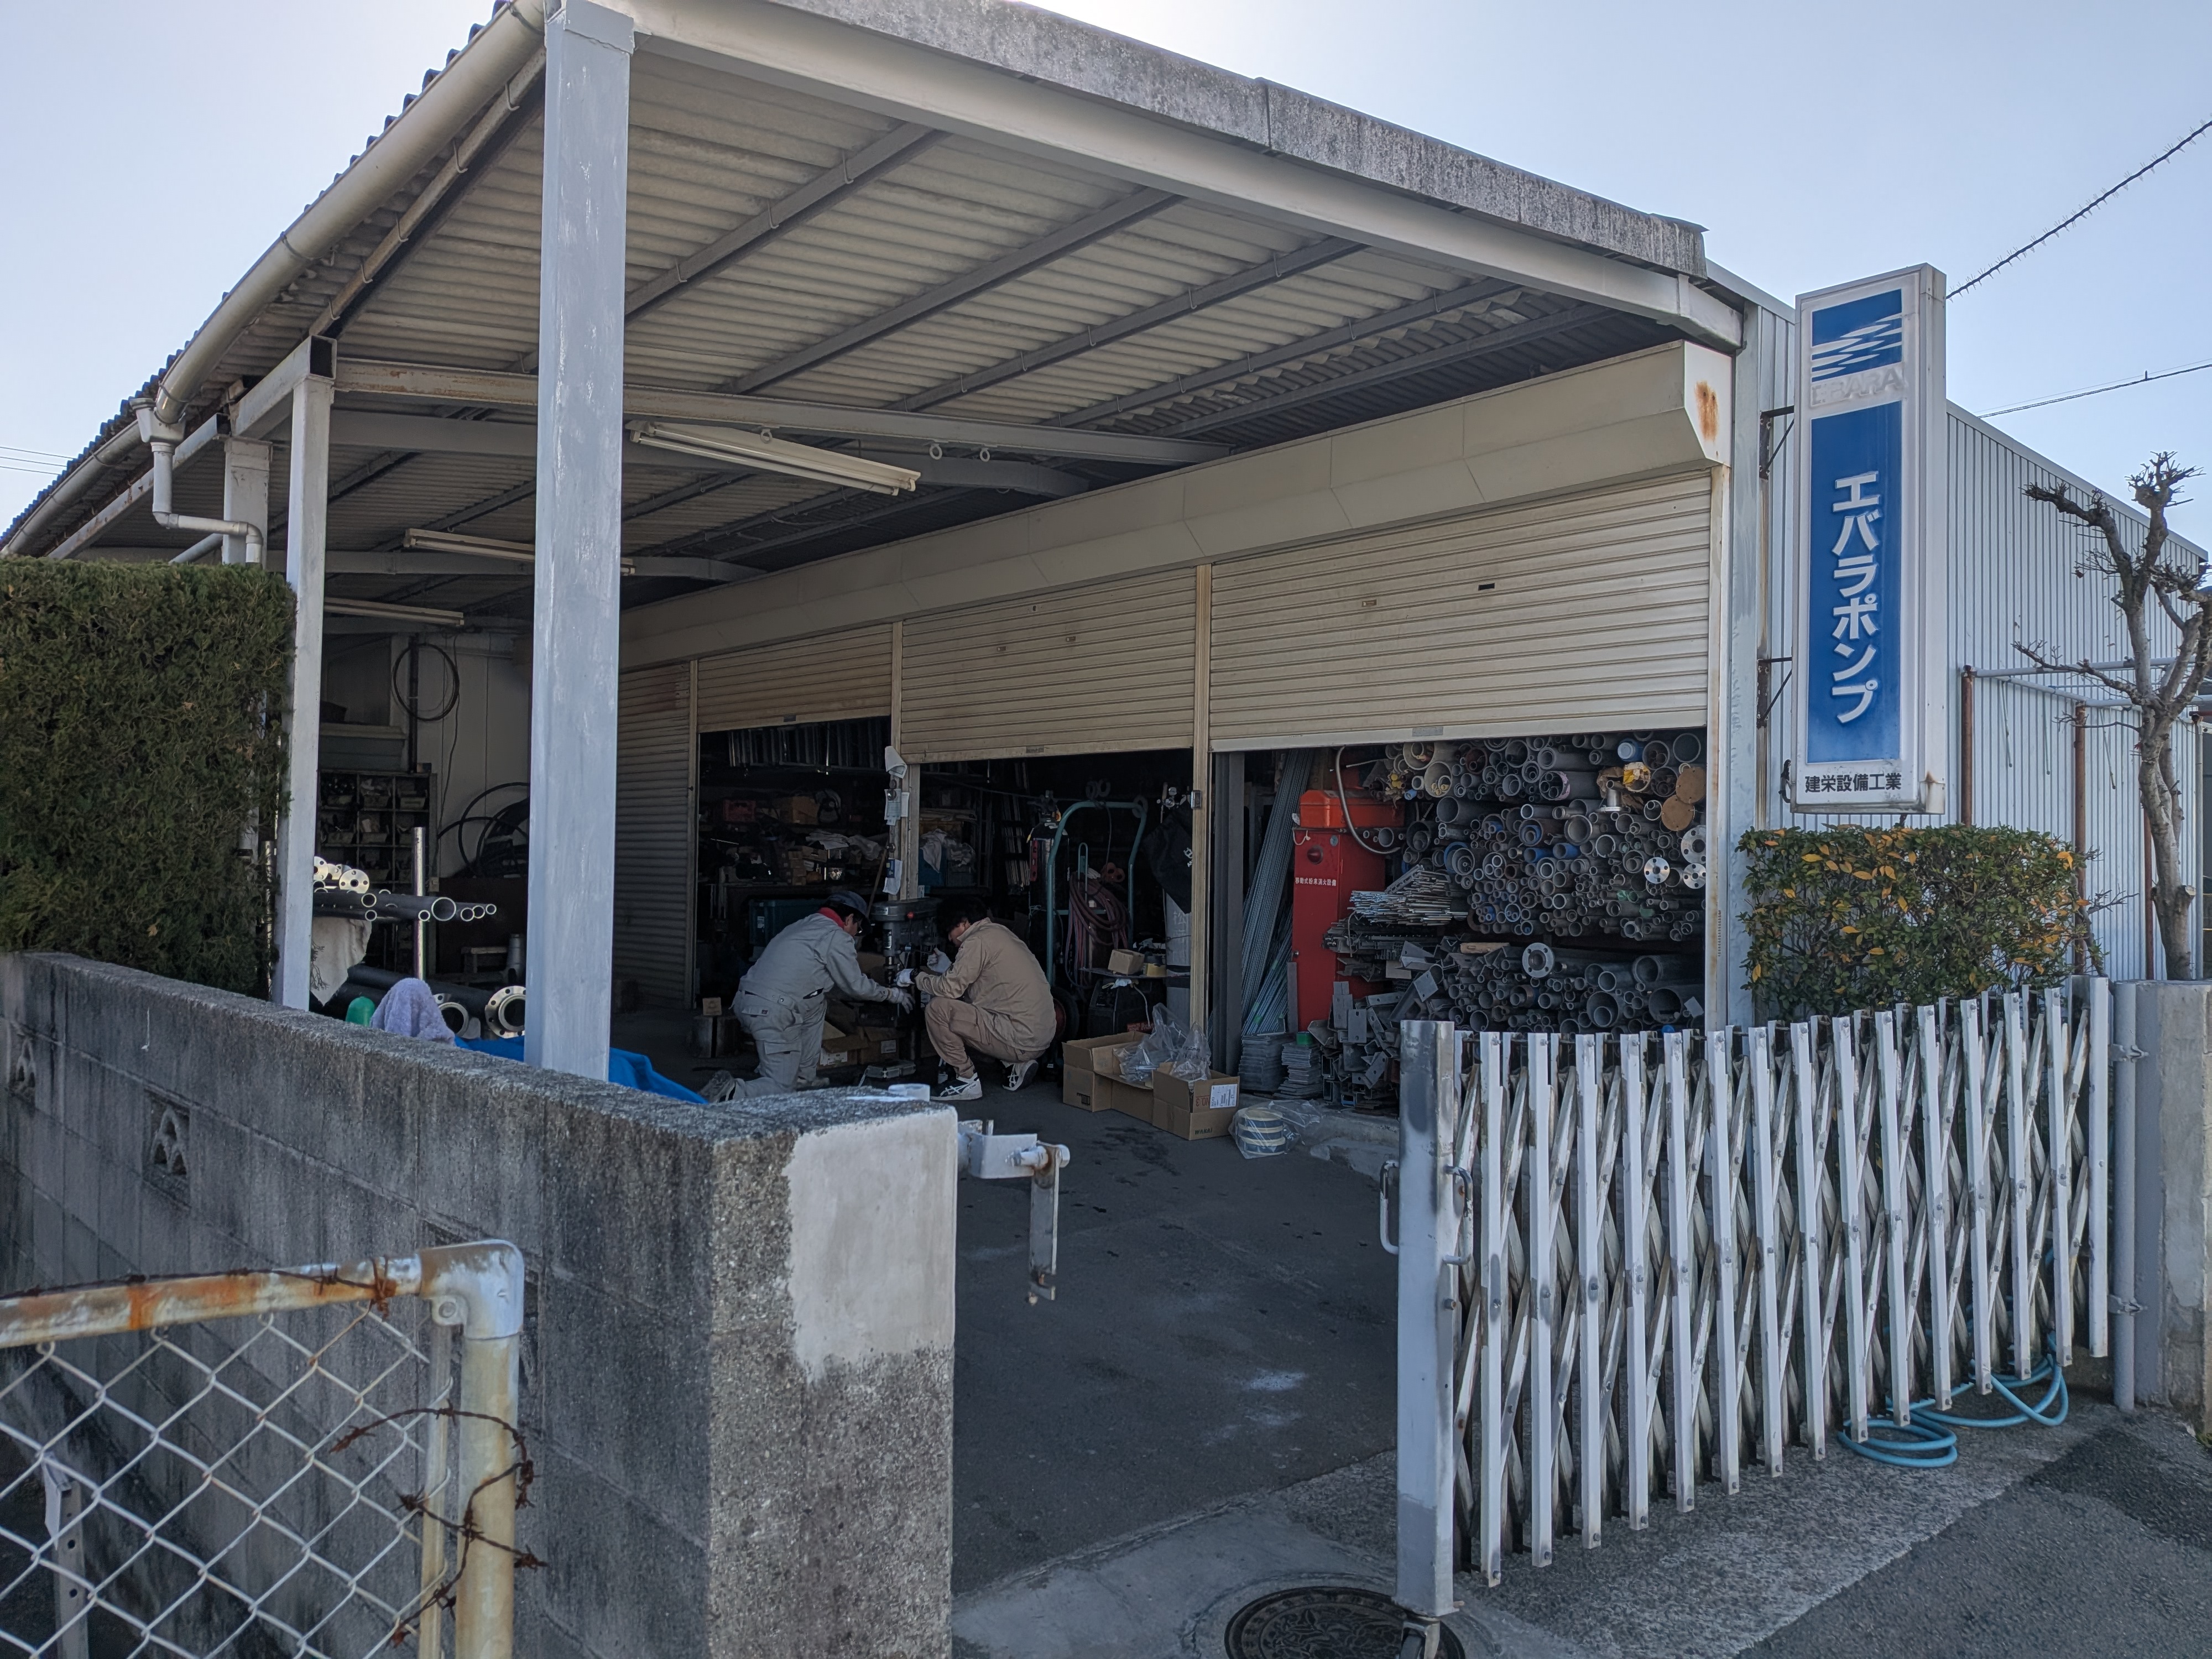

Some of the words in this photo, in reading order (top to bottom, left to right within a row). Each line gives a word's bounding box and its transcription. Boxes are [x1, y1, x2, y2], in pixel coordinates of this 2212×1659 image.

[1832, 471, 1880, 724] エバラポンプ
[1804, 772, 1902, 793] 建栄設備工業
